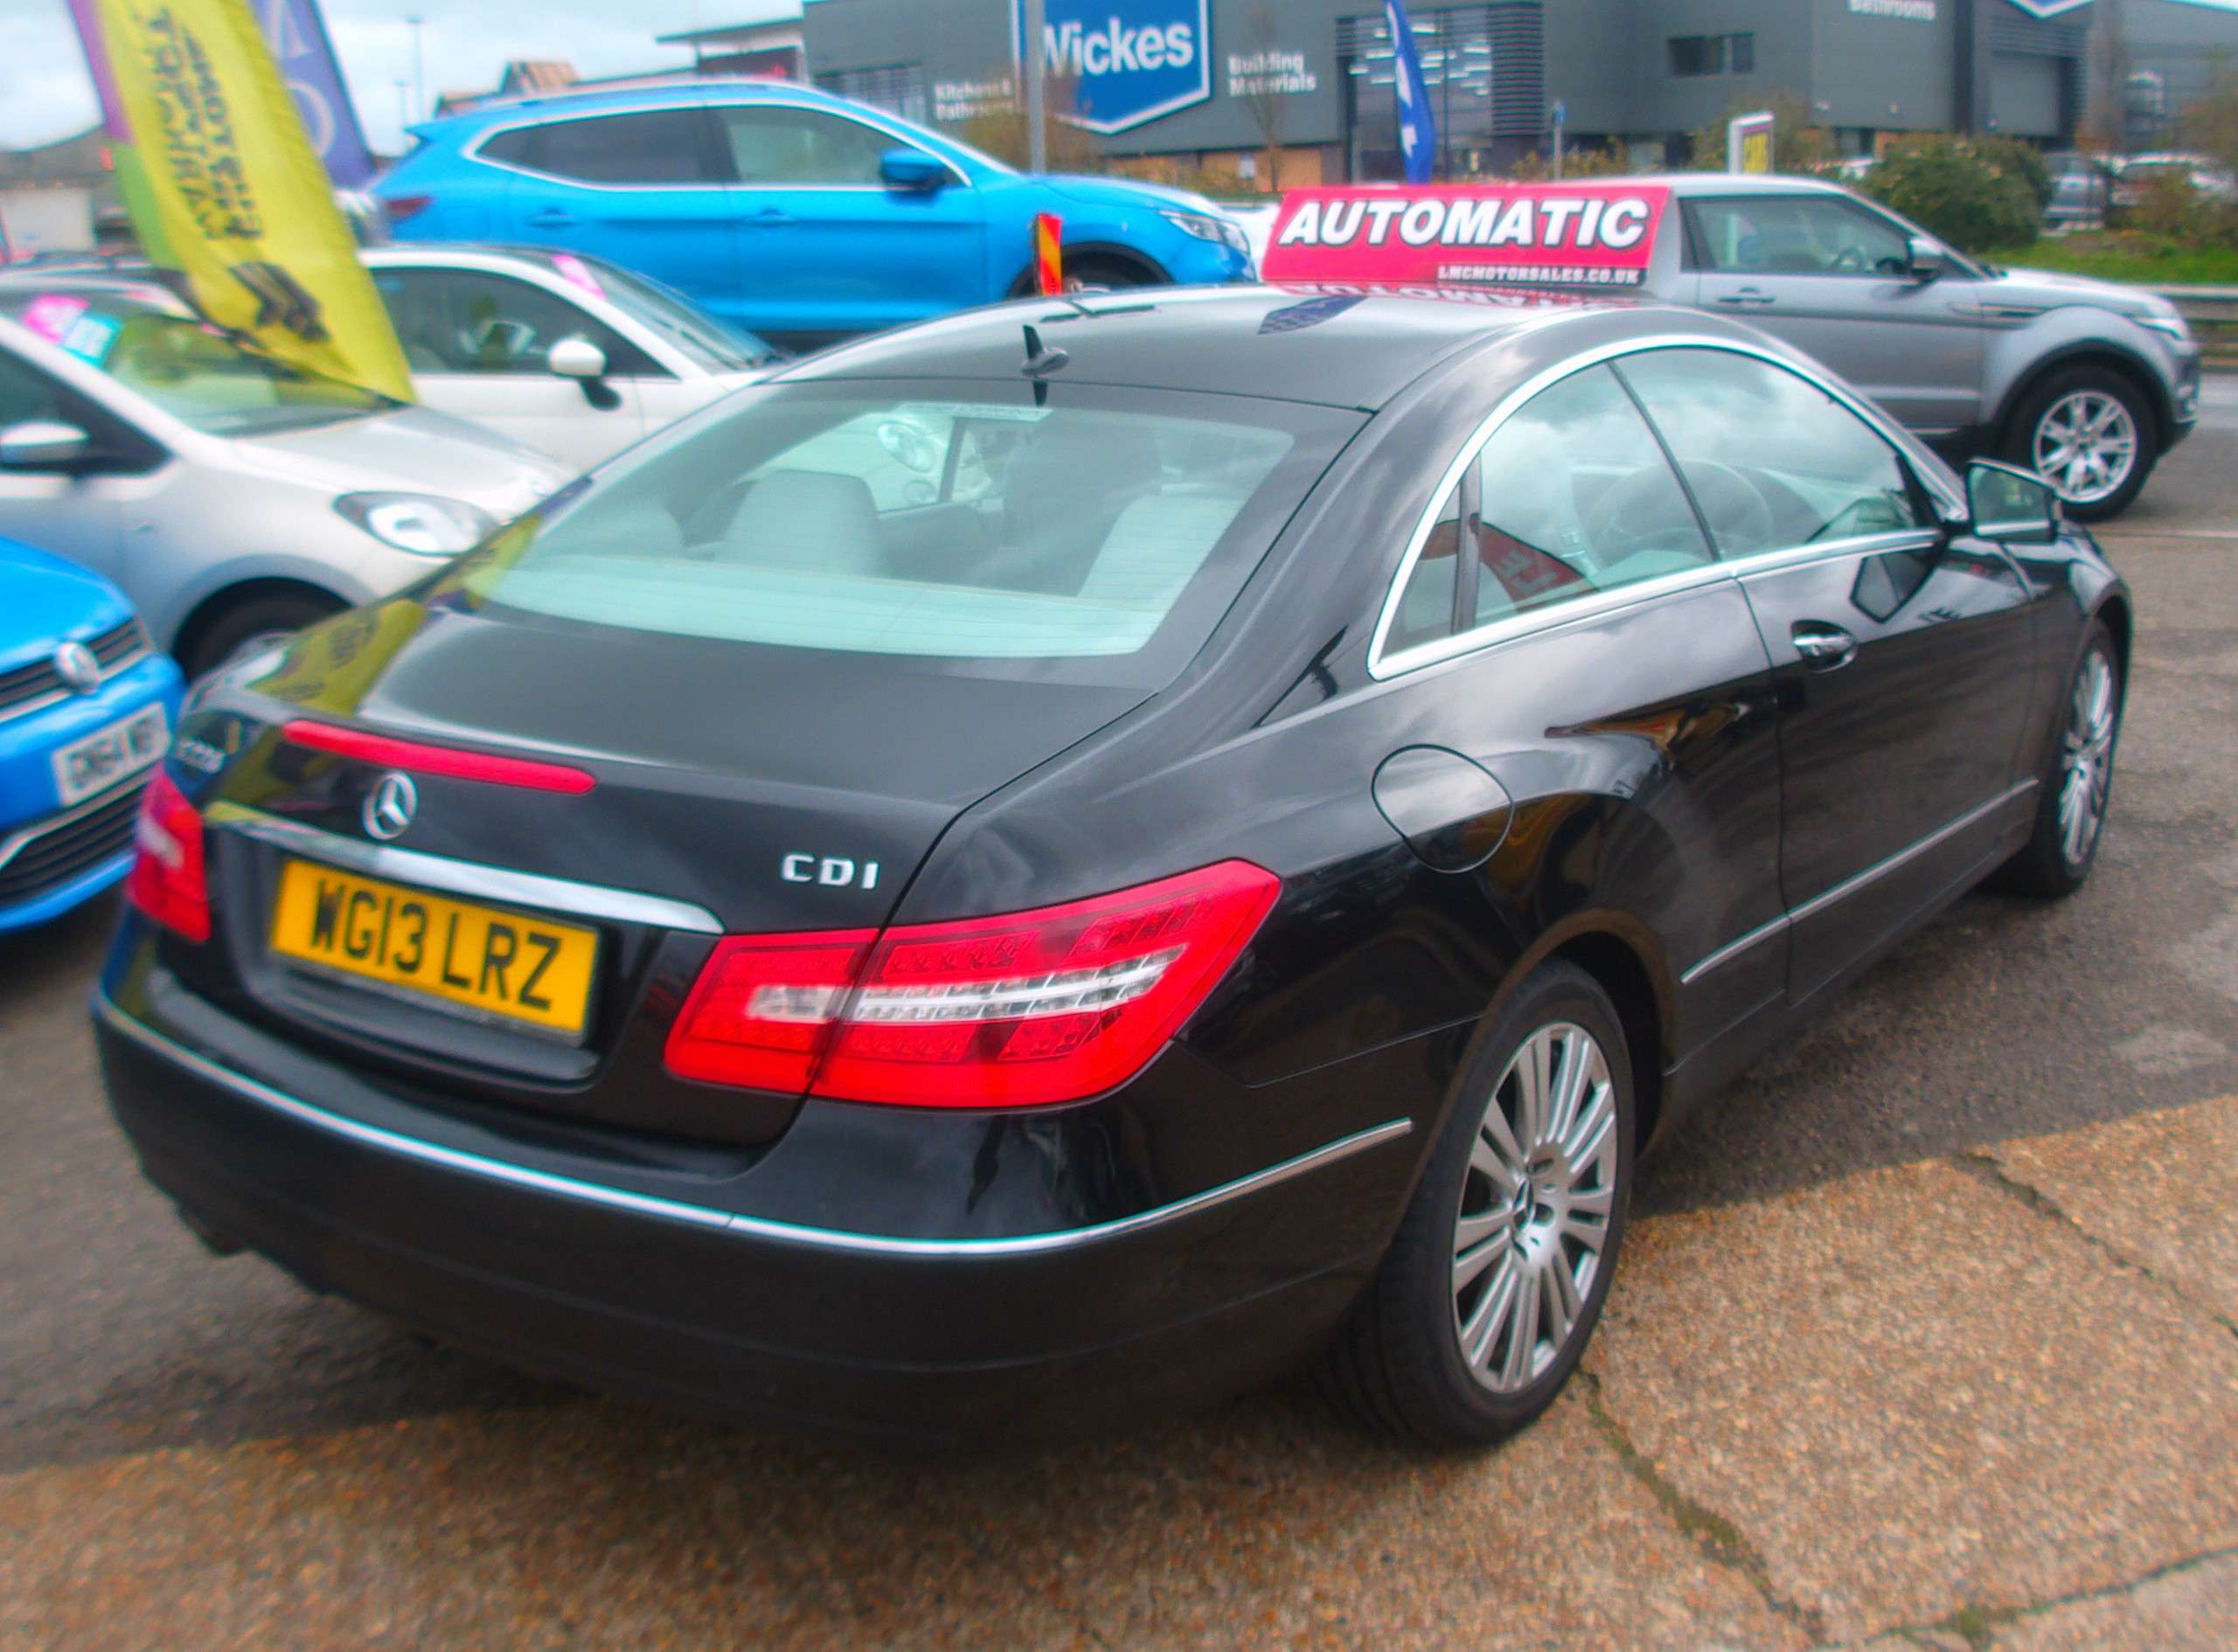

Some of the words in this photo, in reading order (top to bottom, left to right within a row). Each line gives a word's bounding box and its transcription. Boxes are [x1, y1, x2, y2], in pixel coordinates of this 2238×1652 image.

[1228, 51, 1304, 75] Building
[1228, 72, 1317, 98] Materials
[1278, 198, 1651, 250] AUTOMATIC
[781, 853, 879, 891] CDI
[309, 877, 427, 975] WG13
[441, 911, 562, 1012] LRZ
